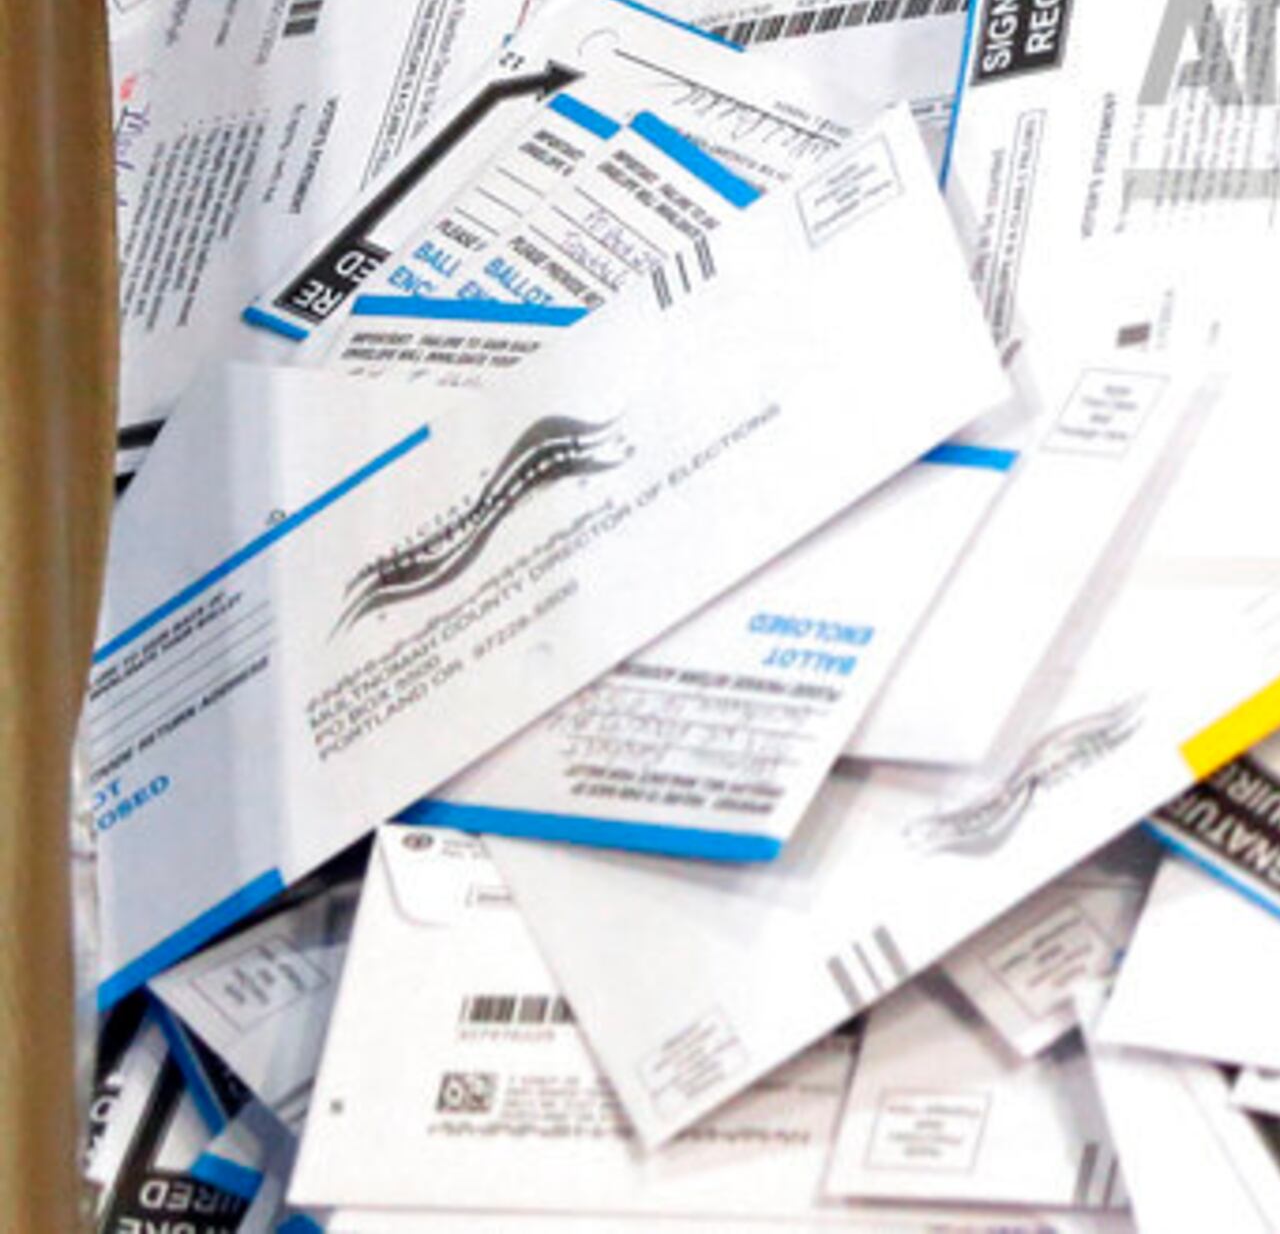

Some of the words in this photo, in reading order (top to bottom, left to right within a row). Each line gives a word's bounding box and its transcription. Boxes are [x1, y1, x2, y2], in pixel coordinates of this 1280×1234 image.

[506, 234, 548, 269] PLEASE
[542, 259, 587, 296] PROVIDE
[305, 632, 441, 732] MULTNOMAH
[438, 574, 529, 643] COUNTY
[525, 501, 635, 582] DIRECTOR
[634, 480, 665, 509] OF
[664, 400, 782, 488] ELECTIONS
[747, 610, 874, 648] ENCLOSED
[762, 645, 856, 676] BALLOT
[310, 717, 345, 747] PO
[344, 682, 397, 723] BOX
[315, 679, 431, 764] PORTLAND
[429, 657, 466, 689] OR
